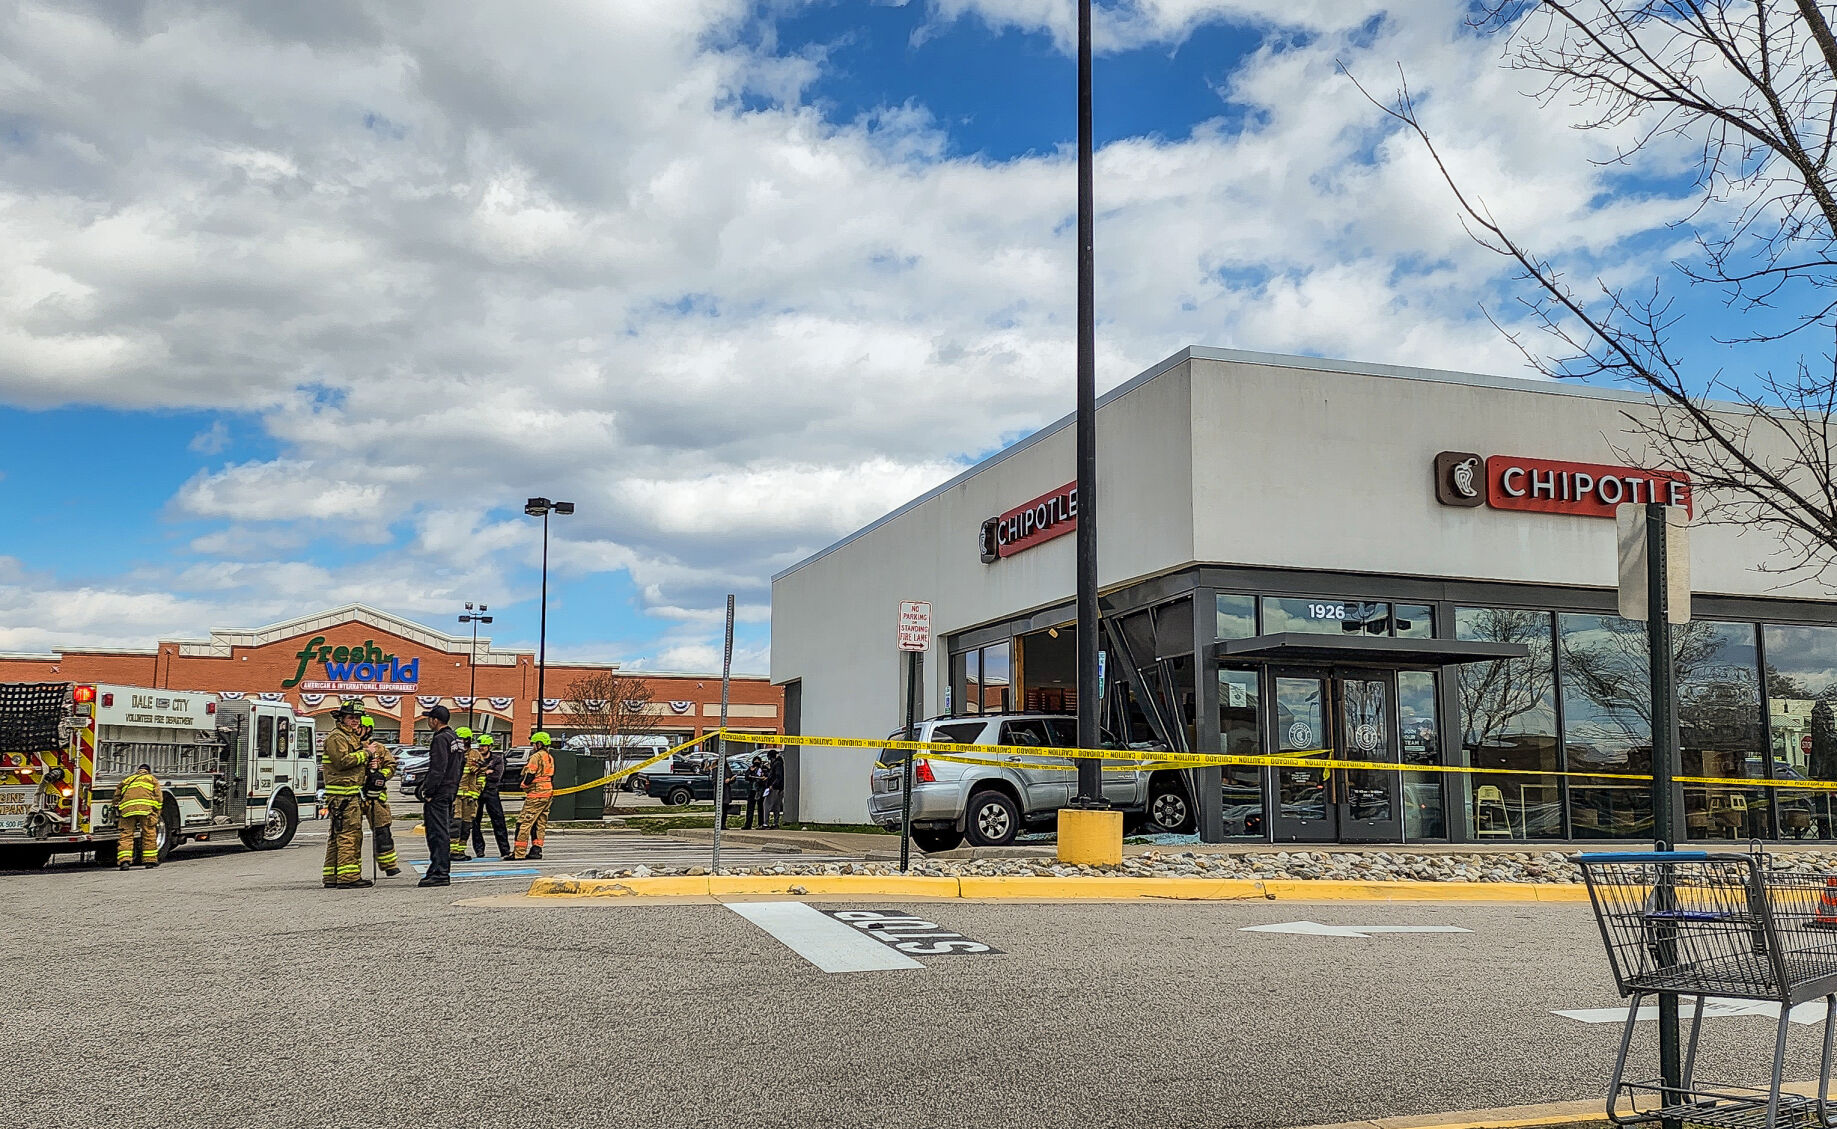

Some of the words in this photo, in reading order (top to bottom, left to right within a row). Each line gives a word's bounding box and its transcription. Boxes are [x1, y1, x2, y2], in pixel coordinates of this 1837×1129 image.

[1503, 467, 1688, 509] CHIPOTLE
[997, 488, 1077, 545] CHIPOTLE
[1307, 603, 1346, 619] 1926
[900, 633, 911, 641] FIRE
[914, 634, 927, 642] LANE
[282, 636, 394, 687] fresh
[325, 657, 419, 683] world
[379, 683, 415, 691] SUPERMARKET
[131, 694, 153, 709] DALE
[172, 698, 189, 712] CITY
[125, 713, 153, 723] VOLUNTEER
[165, 716, 194, 725] DEPARTMENT
[780, 736, 804, 744] CUIDADO
[1017, 747, 1042, 755] CUIDADO
[1141, 752, 1167, 760] CUIDADO
[833, 911, 990, 954] STOP
